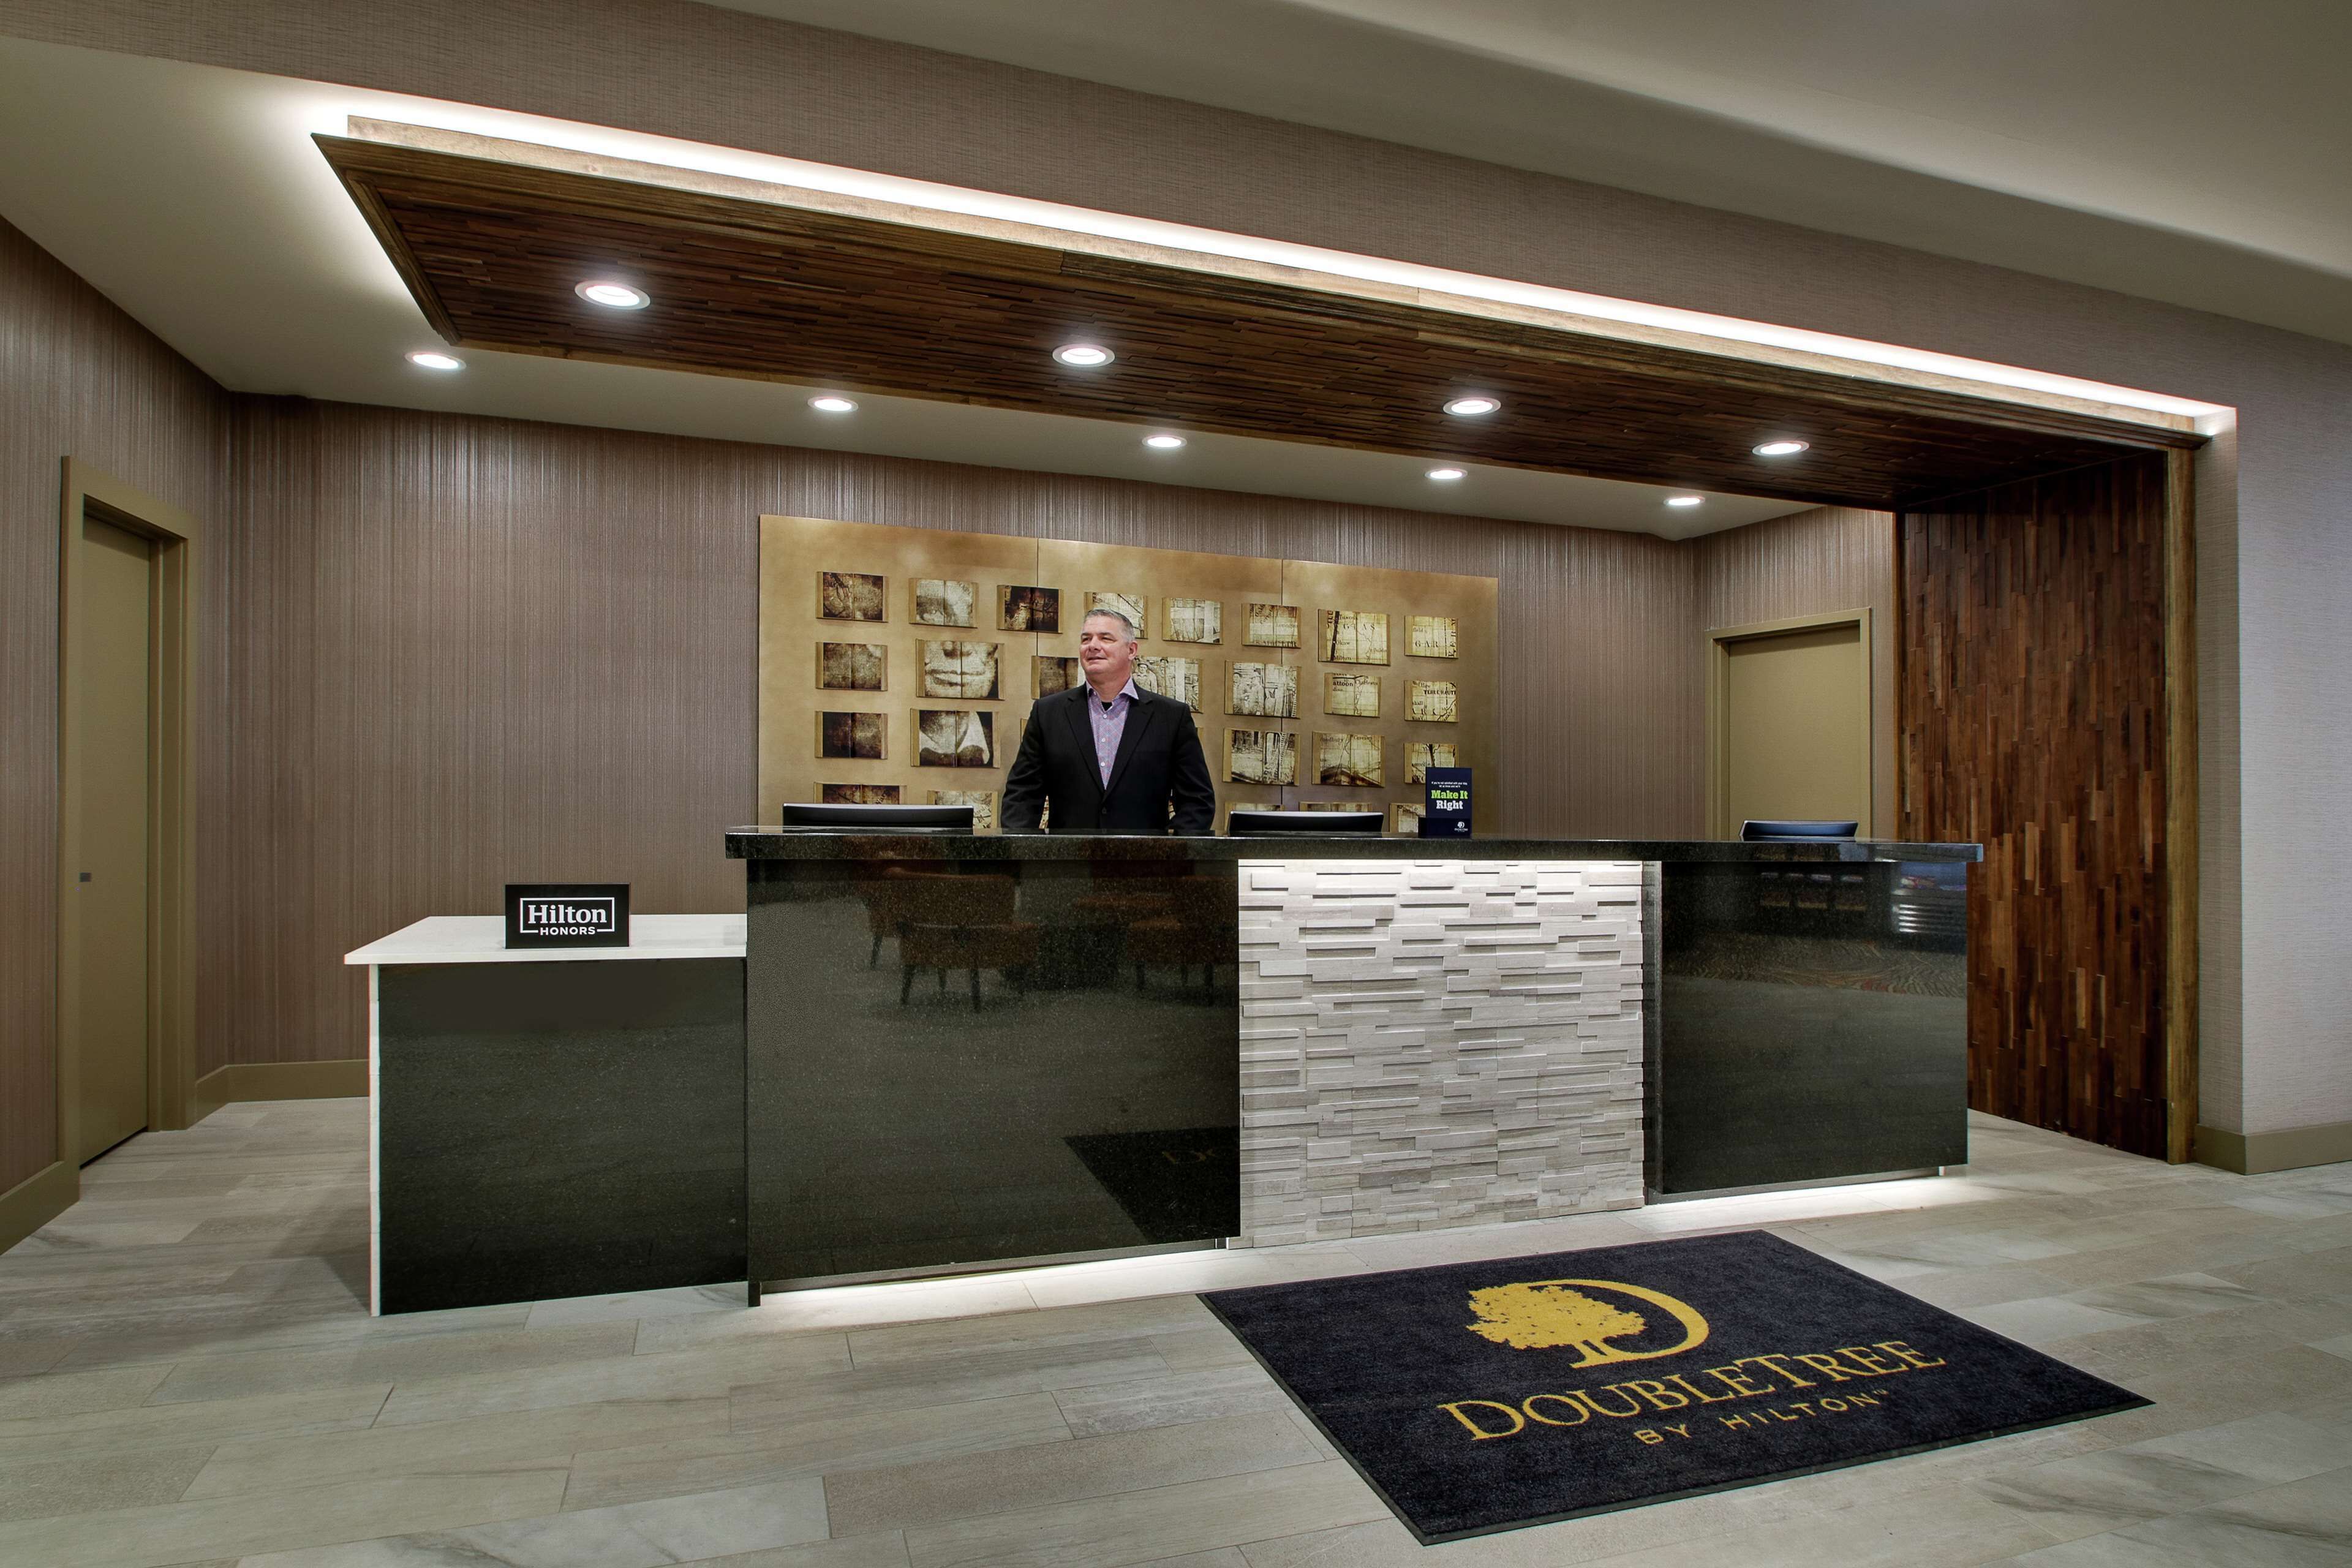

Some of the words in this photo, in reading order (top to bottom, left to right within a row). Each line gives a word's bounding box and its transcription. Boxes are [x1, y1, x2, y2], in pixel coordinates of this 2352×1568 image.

[1431, 790, 1458, 799] Make
[1460, 790, 1468, 799] It
[1436, 800, 1463, 811] Right
[528, 904, 607, 924] Hilton
[540, 926, 596, 935] HONORS
[1436, 1341, 1947, 1440] DOUBLETREE
[1634, 1424, 1692, 1444] BY
